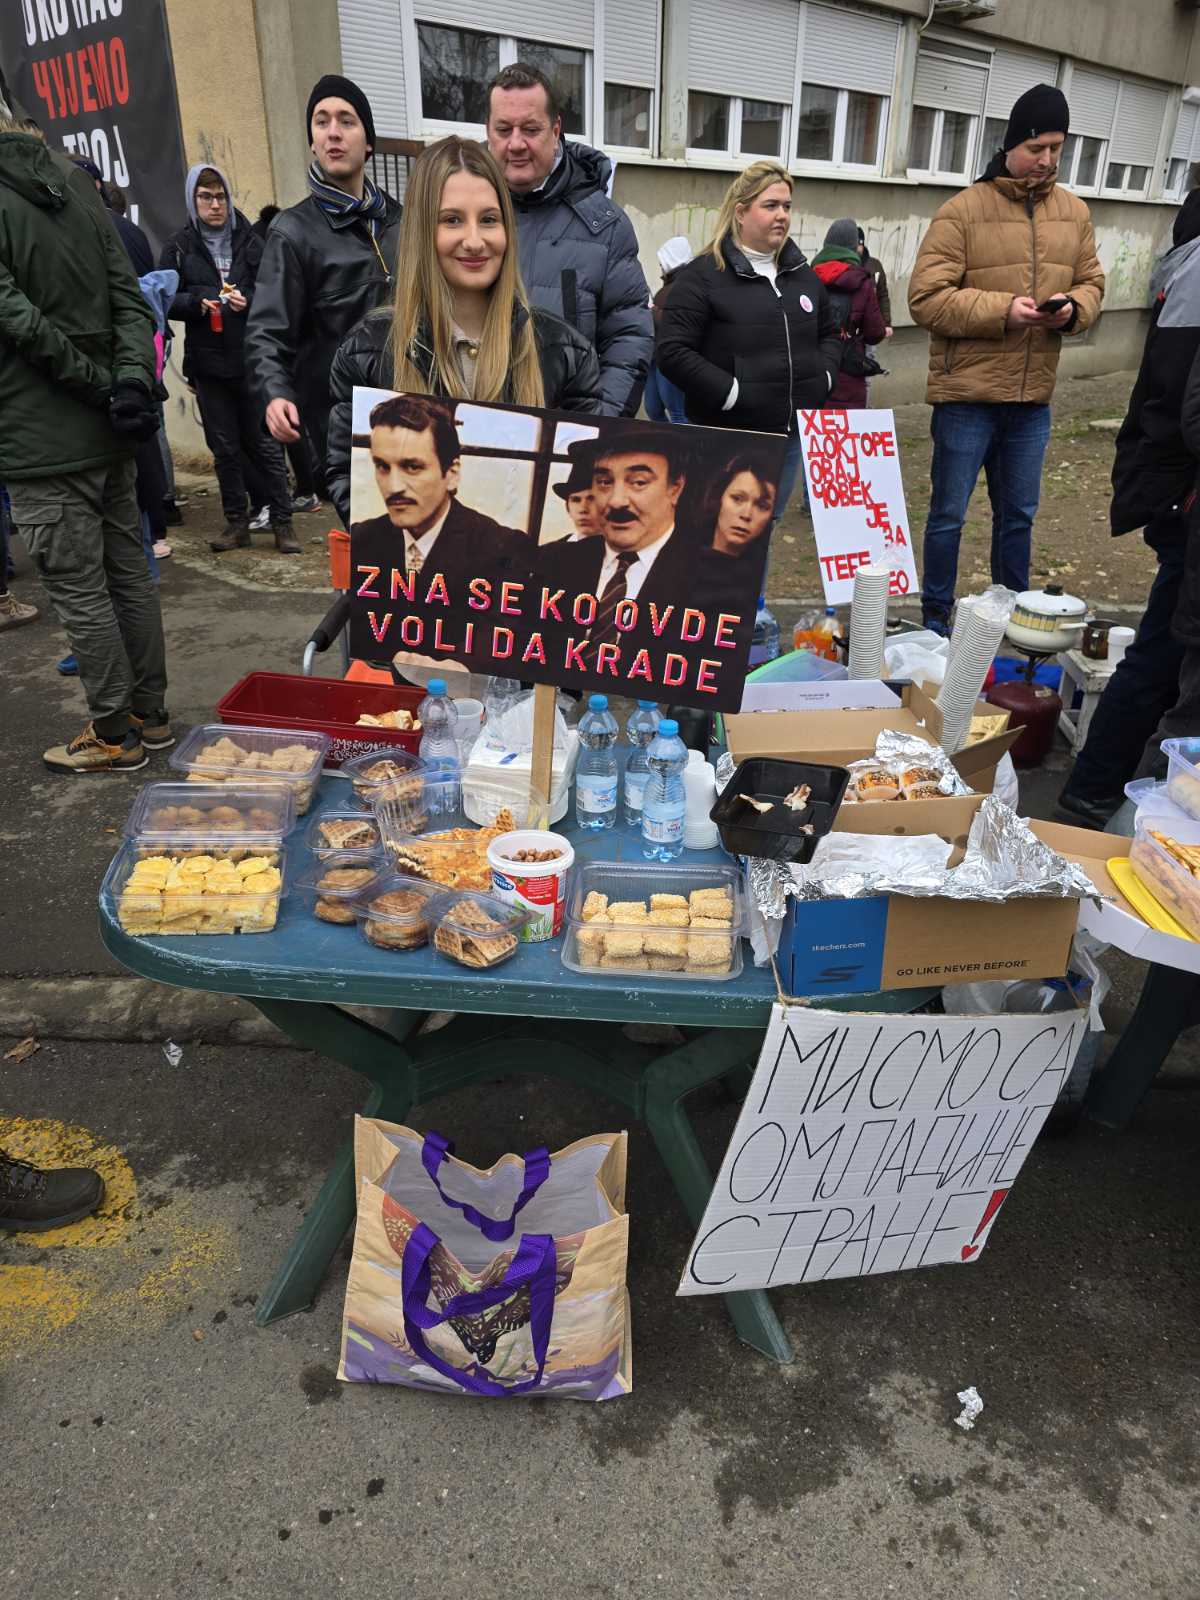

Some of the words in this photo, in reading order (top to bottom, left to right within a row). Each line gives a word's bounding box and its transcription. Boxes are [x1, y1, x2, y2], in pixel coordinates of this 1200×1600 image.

[32, 36, 130, 119] ЧУЈЕМО
[801, 409, 849, 436] ХЕЈ
[807, 431, 895, 461] ДОКТОРЕ
[809, 457, 860, 485] ОВАЈ
[812, 480, 874, 509] ЧОВЕК
[866, 502, 890, 529] ЈЕ
[357, 565, 450, 606] ZNA
[468, 578, 525, 616] SE
[540, 587, 598, 626] KO
[614, 599, 742, 649] OVDE
[367, 611, 474, 654] VOLI
[491, 626, 547, 665] DA
[564, 637, 723, 694] KRADE
[896, 968, 913, 976] GO
[916, 966, 941, 975] LIKE
[943, 963, 981, 973] NEVER
[984, 960, 1030, 970] BEFORE
[758, 1024, 883, 1114] МИ
[869, 1027, 1001, 1112] СМО
